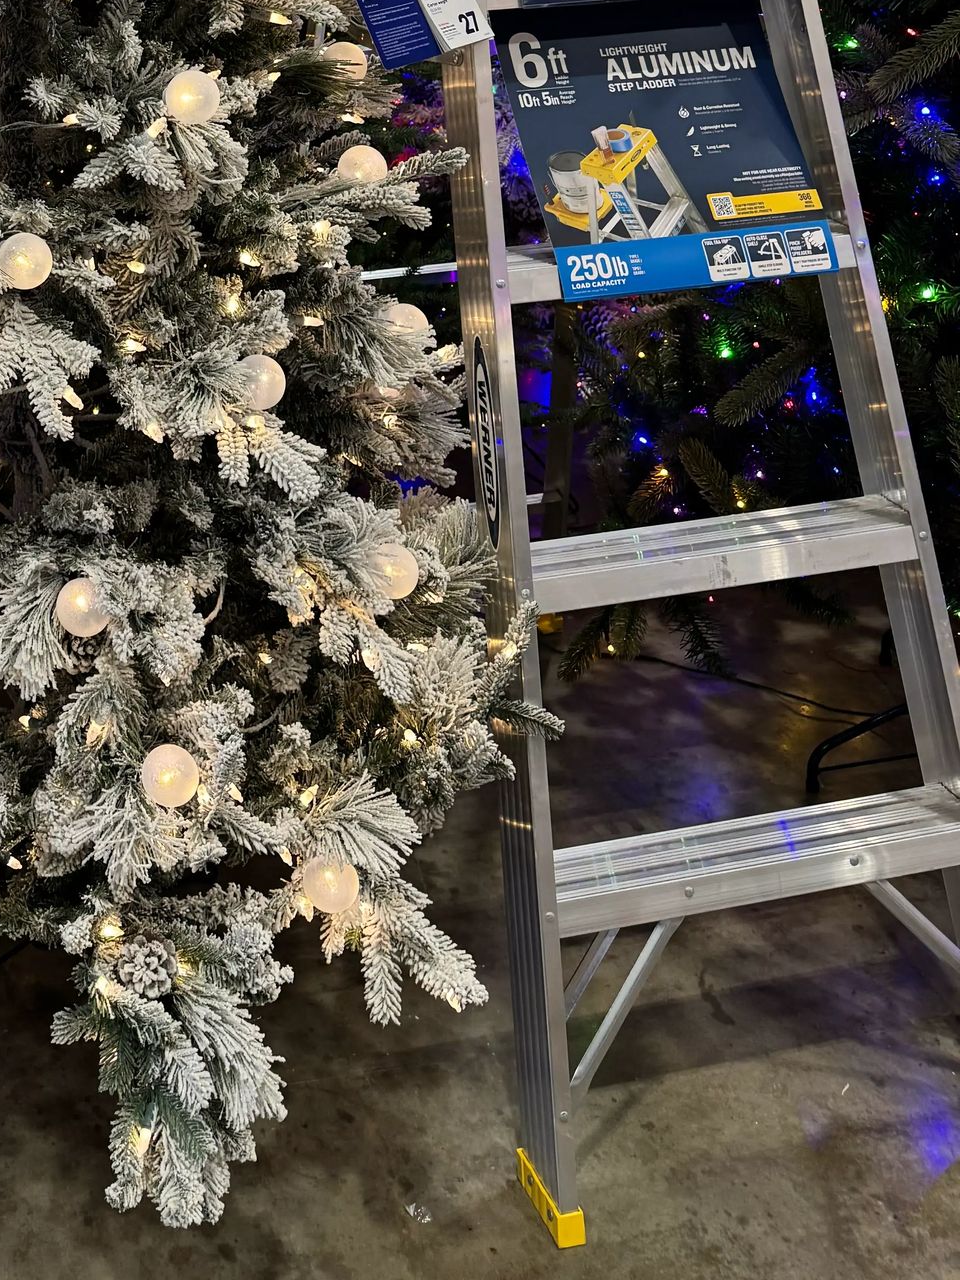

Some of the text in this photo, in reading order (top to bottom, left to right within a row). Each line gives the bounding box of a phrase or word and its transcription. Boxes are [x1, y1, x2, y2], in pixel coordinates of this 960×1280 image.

[458, 10, 479, 34] 27
[600, 42, 668, 58] LIGHTWEIGHT
[606, 46, 757, 82] ALUMINUM
[608, 78, 676, 93] STEP LADDER
[518, 91, 560, 108] 10ft 5in
[566, 252, 630, 282] 250lb
[572, 278, 626, 290] LOAD CAPACITY
[478, 380, 496, 508] WERNER
